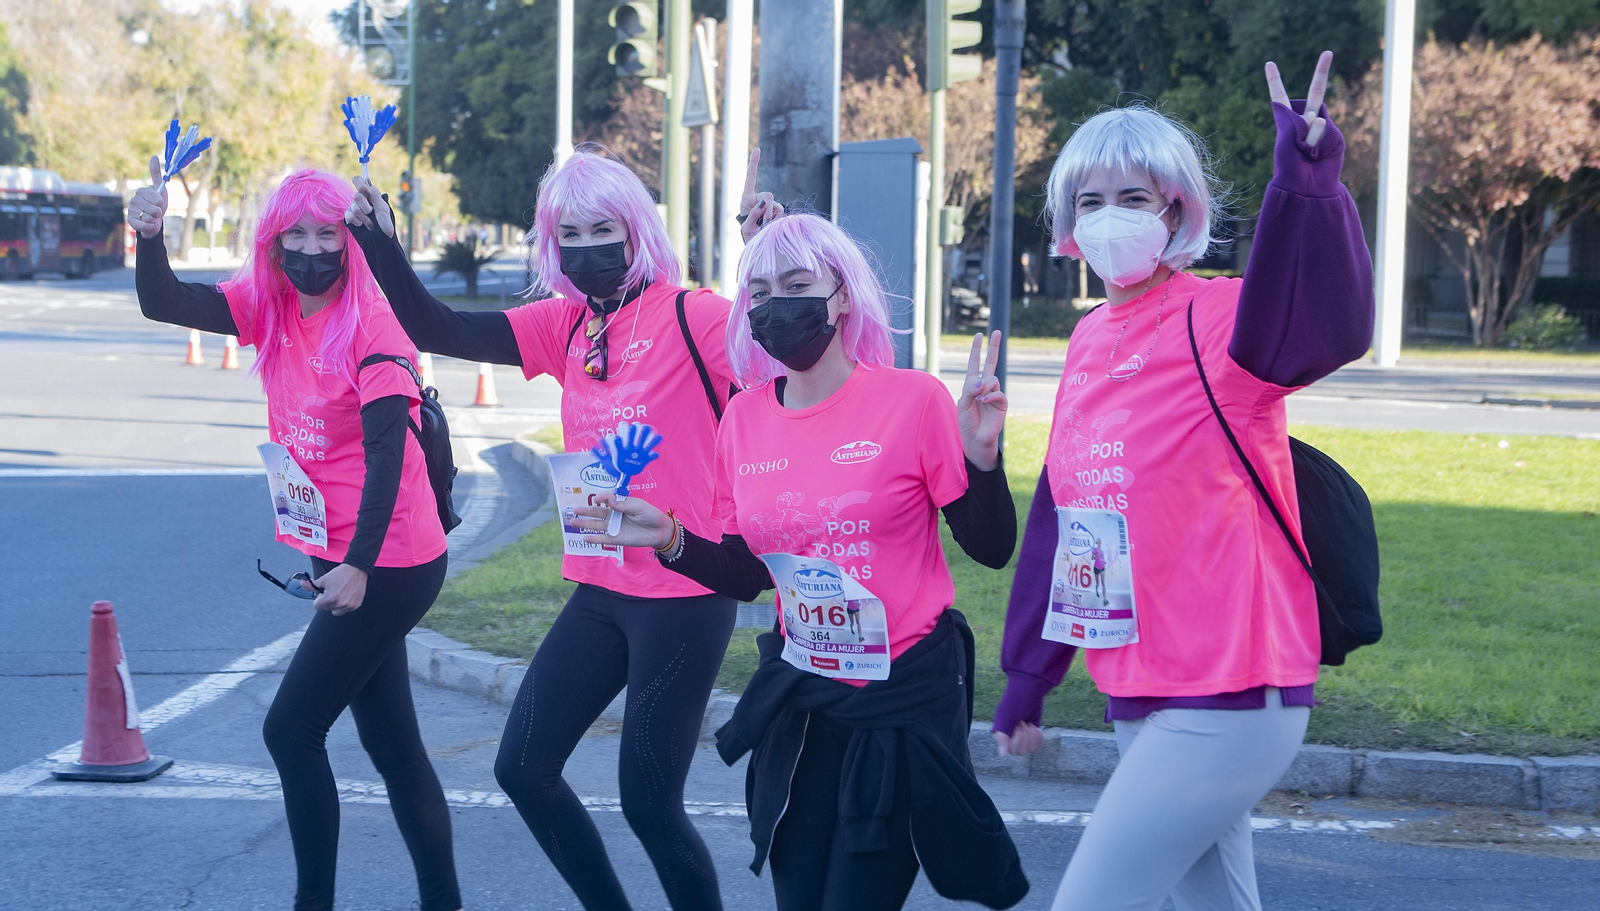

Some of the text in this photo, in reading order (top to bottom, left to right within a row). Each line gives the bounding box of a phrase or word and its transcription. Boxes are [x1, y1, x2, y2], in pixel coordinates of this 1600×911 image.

[300, 411, 325, 430] POR
[613, 405, 647, 421] POR
[290, 425, 325, 447] ODAS
[835, 449, 878, 460] ASTURIANA
[1090, 441, 1124, 460] POR
[739, 458, 789, 476] OYSHO
[1075, 466, 1125, 487] TODAS
[288, 482, 311, 504] 016
[827, 519, 871, 536] POR
[568, 539, 598, 549] OYSHO
[812, 541, 870, 558] TODAS
[798, 602, 846, 627] 016
[1085, 609, 1110, 619] MUJER
[810, 630, 830, 641] 364
[1101, 629, 1129, 637] ZURICH
[792, 634, 865, 653] CARRERA DE LA MUJER
